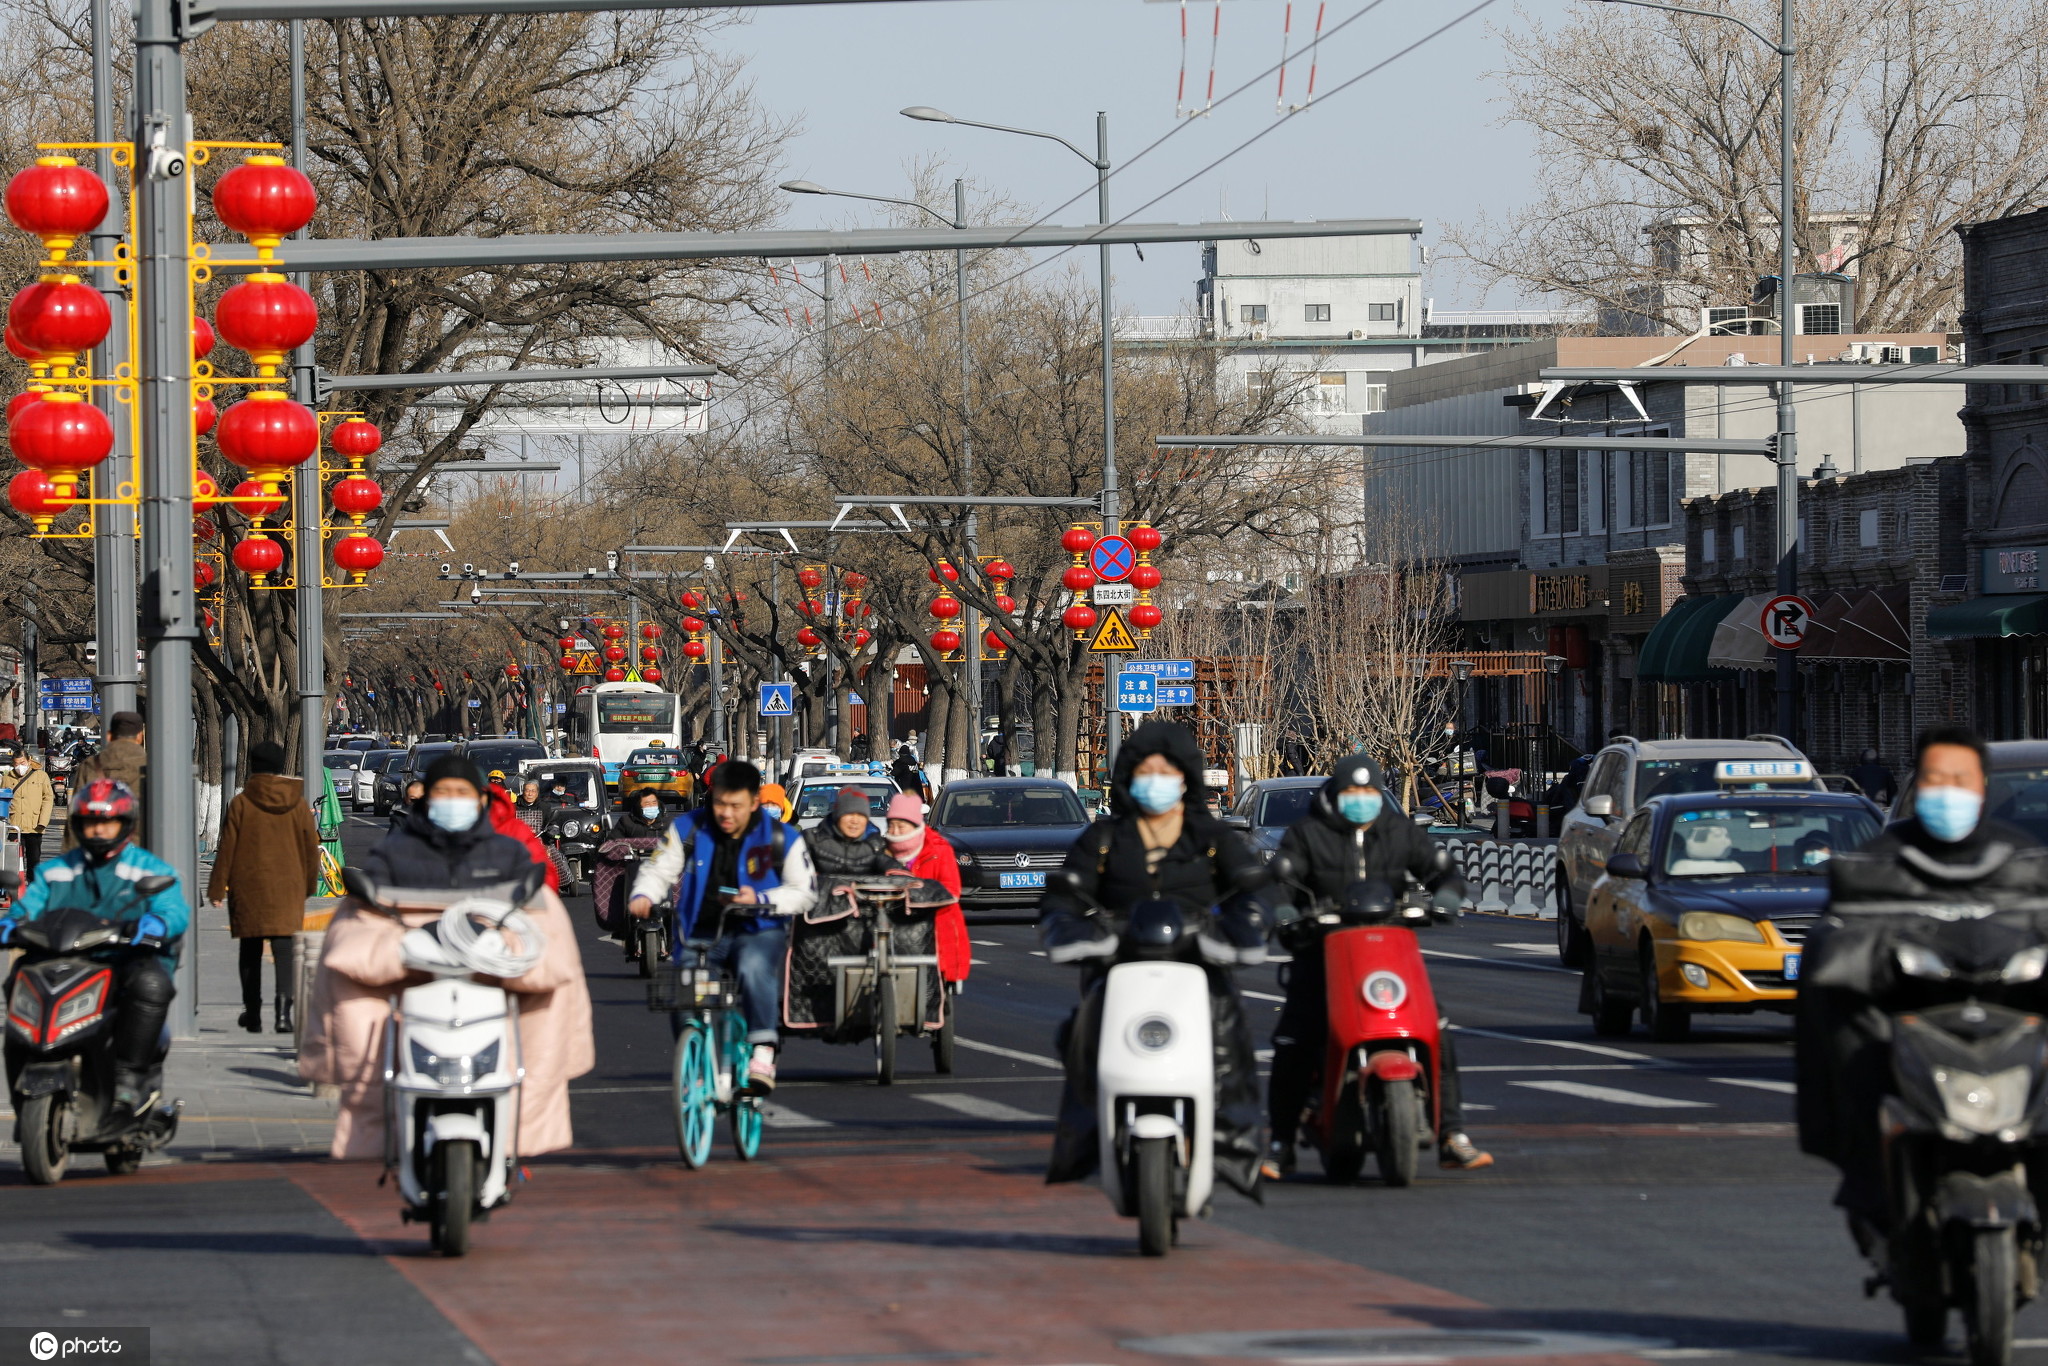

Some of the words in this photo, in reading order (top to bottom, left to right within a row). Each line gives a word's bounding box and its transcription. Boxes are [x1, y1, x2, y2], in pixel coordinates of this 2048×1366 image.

[1096, 589, 1132, 600] 东四北大街
[1128, 663, 1165, 672] 公共卫生间
[1120, 693, 1154, 704] 交通安全
